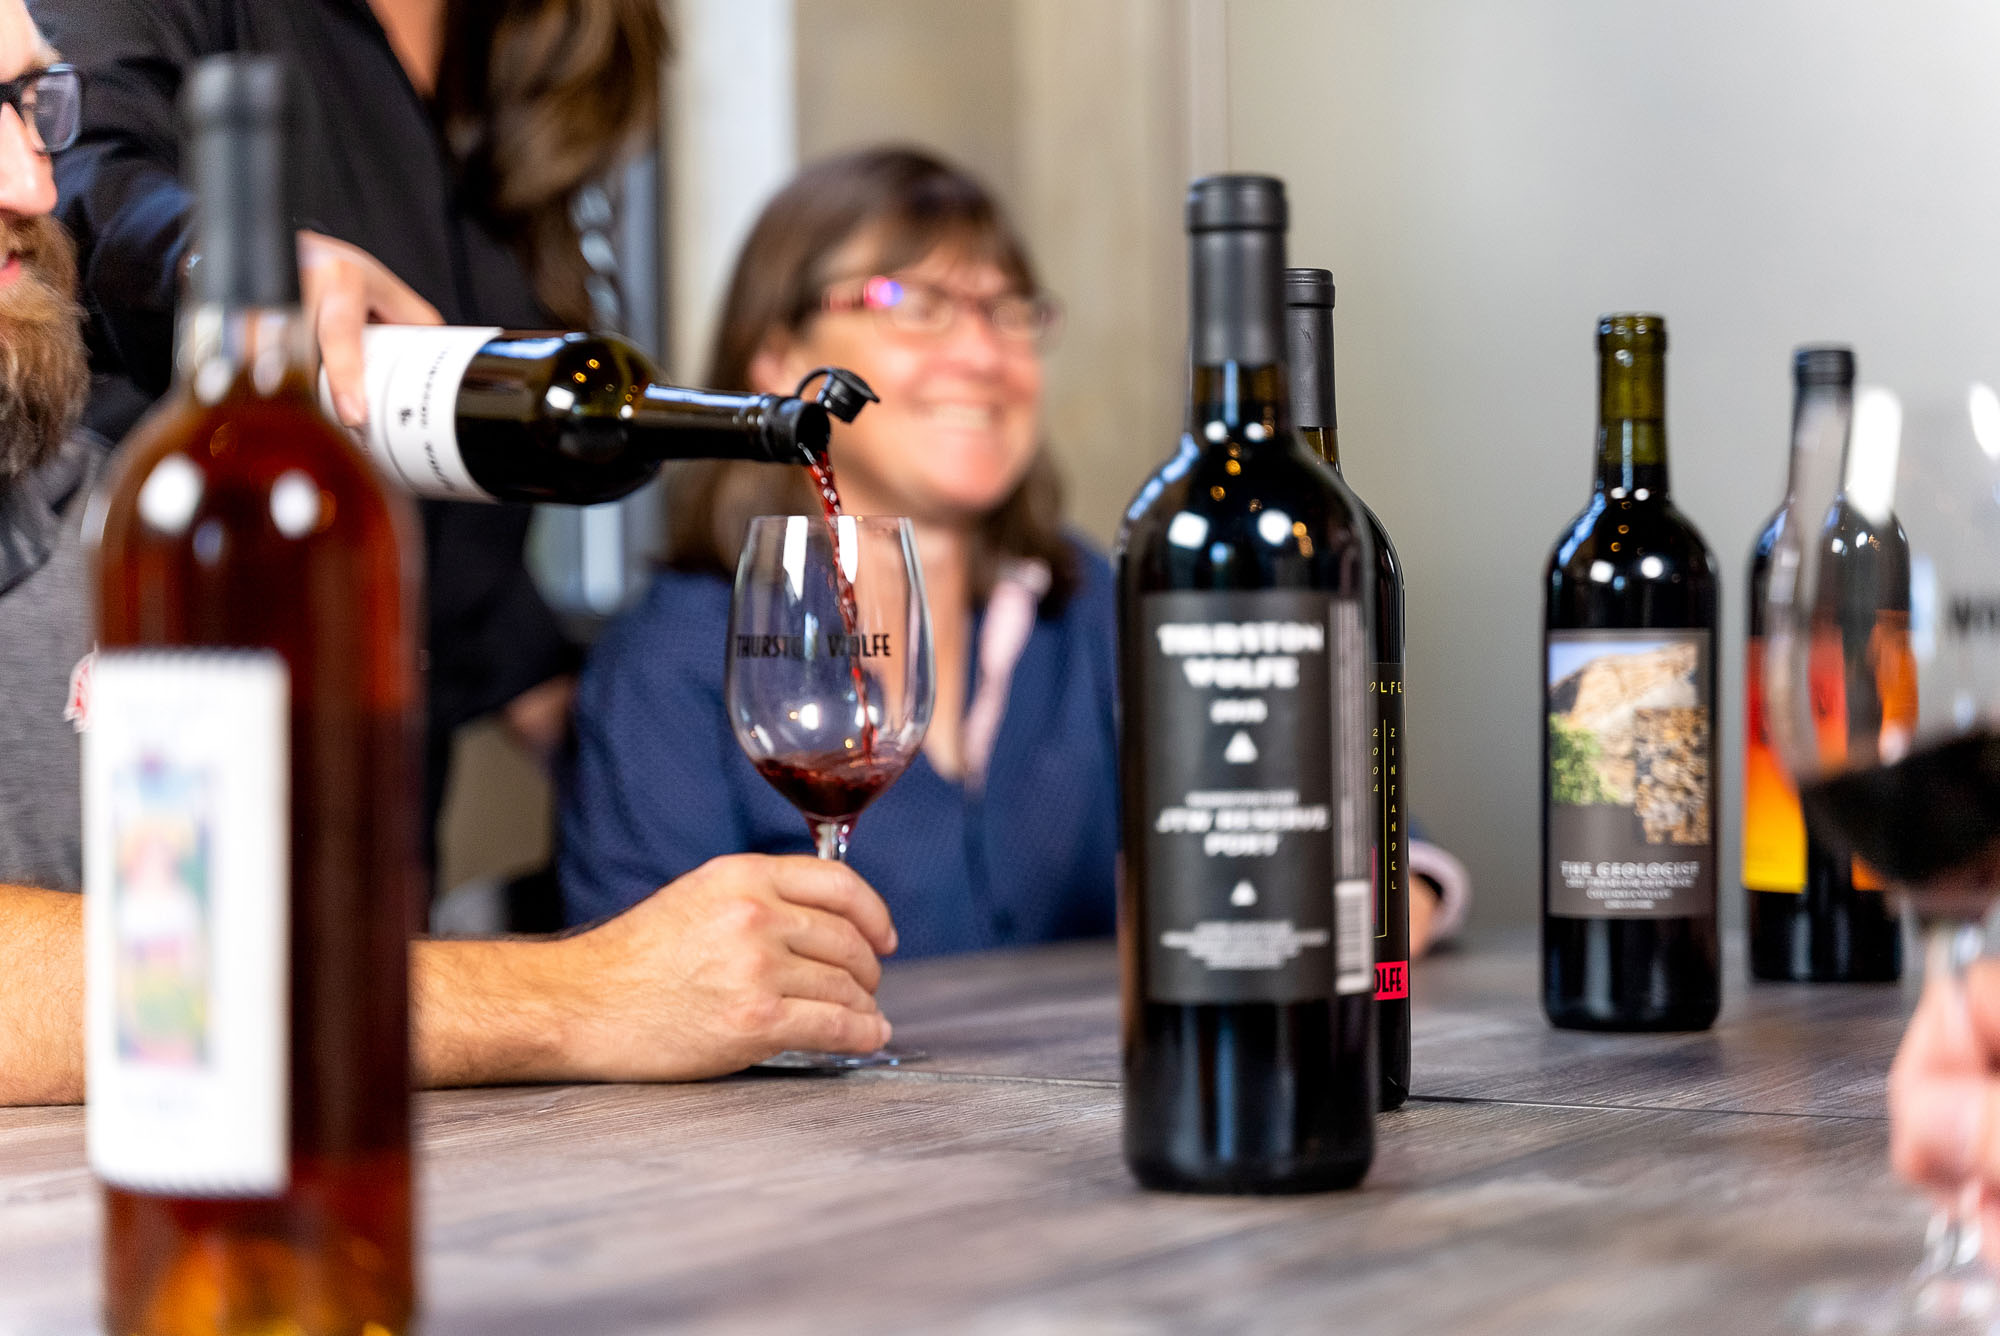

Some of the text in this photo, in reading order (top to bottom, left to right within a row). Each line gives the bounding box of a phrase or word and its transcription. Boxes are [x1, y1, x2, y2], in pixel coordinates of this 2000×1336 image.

[736, 633, 891, 658] THURSTO WOLFE
[1390, 728, 1398, 889] ZINFANDEL
[1560, 861, 1699, 879] THE GEOLOGIST
